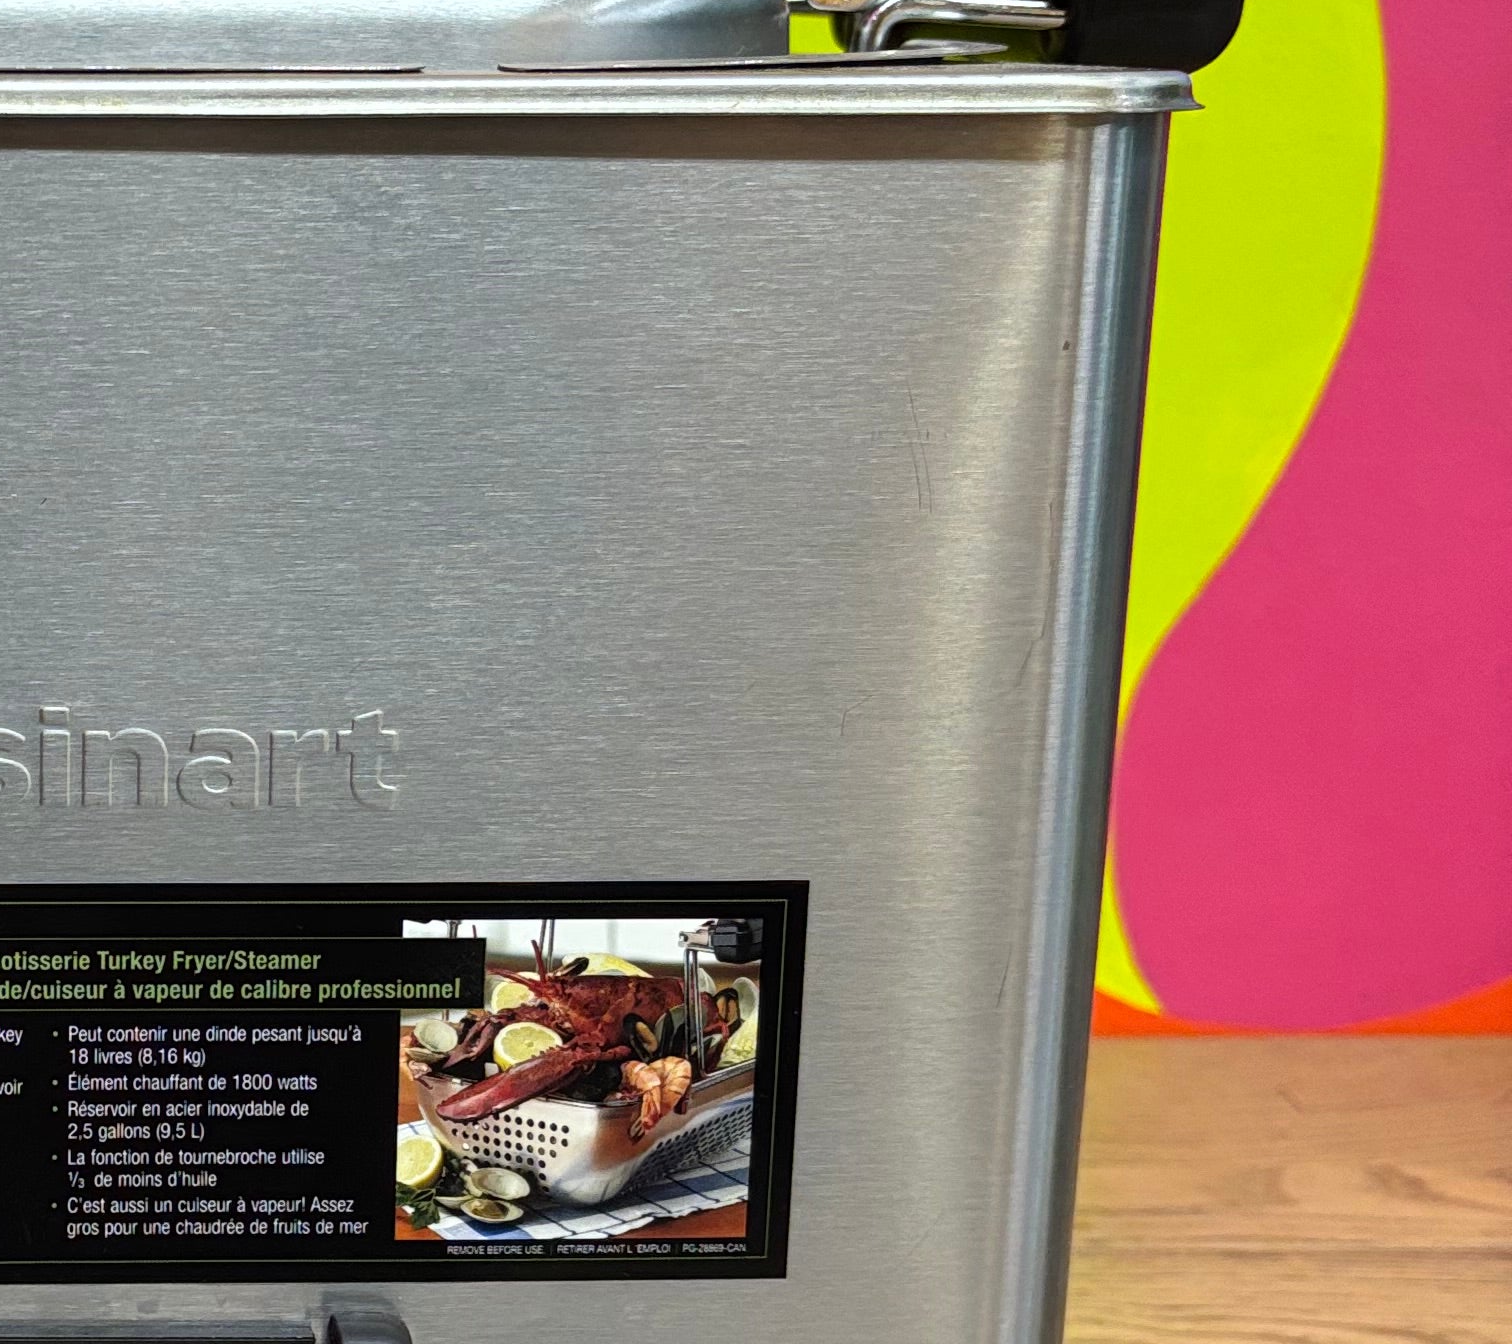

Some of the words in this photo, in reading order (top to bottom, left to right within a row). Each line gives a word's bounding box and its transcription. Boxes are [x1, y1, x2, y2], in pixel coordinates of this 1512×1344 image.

[96, 950, 166, 975] Turkey
[172, 950, 322, 974] Fryer/Steamer
[113, 979, 126, 1000] à
[132, 983, 204, 1004] vapeur
[209, 979, 235, 1000] de
[240, 979, 312, 1000] calibre
[318, 977, 461, 1003] professionnel
[68, 1025, 103, 1043] Peut
[106, 1025, 168, 1043] contenir
[172, 1028, 201, 1042] une
[205, 1025, 247, 1042] dinde
[251, 1025, 303, 1045] pesant
[69, 1047, 89, 1065] 18
[93, 1047, 133, 1065] livres
[137, 1047, 178, 1067] (8,16
[182, 1047, 206, 1068] kg)
[68, 1070, 129, 1091] Élément
[132, 1073, 204, 1091] chauffant
[207, 1073, 227, 1091] de
[232, 1073, 273, 1091] 1800
[276, 1074, 318, 1091] watts
[67, 1100, 138, 1118] Réservoir
[141, 1103, 161, 1117] en
[165, 1100, 203, 1117] acier
[207, 1099, 286, 1120] inoxydable
[290, 1100, 310, 1117] de
[67, 1122, 94, 1141] 2,5
[97, 1122, 151, 1143] gallons
[155, 1122, 186, 1142] (9,5
[190, 1122, 205, 1142] L)
[67, 1149, 86, 1166] La
[90, 1148, 150, 1166] fonction
[154, 1148, 174, 1166] de
[178, 1148, 277, 1165] tournebroche
[281, 1148, 325, 1165] utilise
[93, 1171, 113, 1188] de
[118, 1171, 163, 1188] moins
[109, 1197, 149, 1214] aussi
[154, 1199, 173, 1214] un
[177, 1196, 233, 1213] cuiseur
[236, 1196, 246, 1213] à
[250, 1196, 306, 1216] vapeur!
[309, 1195, 355, 1213] Assez
[66, 1222, 100, 1240] gros
[104, 1222, 139, 1239] pour
[142, 1221, 171, 1236] une
[175, 1218, 245, 1236] chaudrée
[249, 1218, 269, 1235] de
[272, 1217, 311, 1235] fruits
[315, 1218, 335, 1235] de
[339, 1221, 369, 1235] mer
[446, 1244, 486, 1255] REMOVE
[486, 1244, 524, 1255] BEFORE
[524, 1244, 545, 1255] USE
